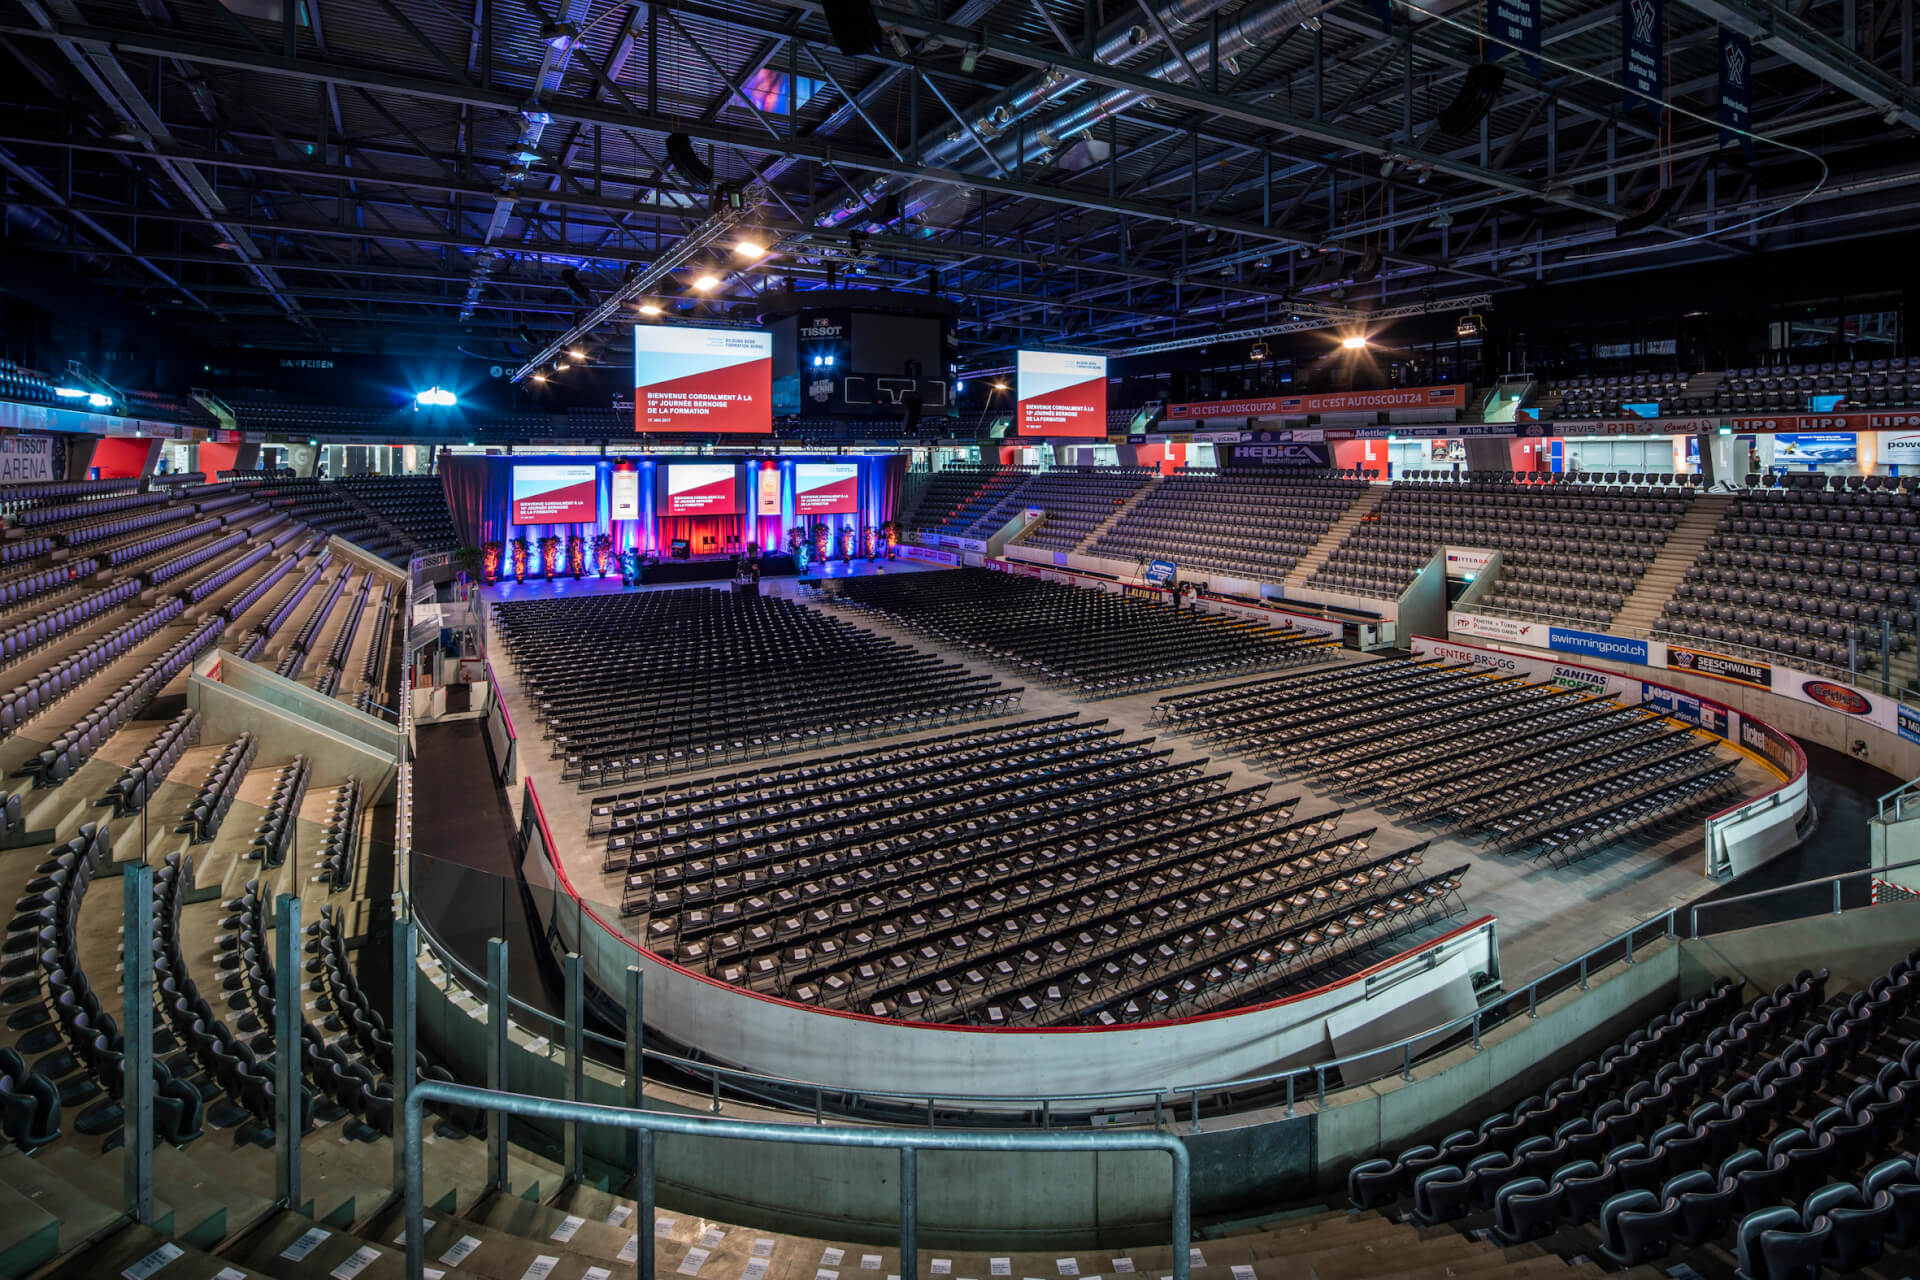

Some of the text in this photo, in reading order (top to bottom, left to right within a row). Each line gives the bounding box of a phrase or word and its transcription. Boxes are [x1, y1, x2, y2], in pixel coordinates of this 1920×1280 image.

[800, 326, 843, 337] TISSOT
[648, 392, 687, 400] BIENVENUE
[1308, 392, 1422, 409] ICI C'EST AUTOSCOUT24
[1192, 407, 1201, 415] ICI
[1221, 402, 1277, 413] AUTOSCOUT24
[1607, 423, 1635, 433] RJB
[1733, 420, 1777, 430] LIPO
[1800, 417, 1847, 429] LIPO
[1871, 415, 1920, 427] LIPO
[1355, 428, 1389, 438] Mettler
[16, 438, 47, 454] TISSOT
[2, 458, 47, 480] ARENA
[1551, 633, 1645, 656] swimmingpool.ch
[1433, 647, 1472, 662] CENTRE
[1474, 654, 1515, 670] BRÜGG
[1698, 656, 1762, 677] SEESCHWALBE
[1555, 667, 1607, 685] SANITAS
